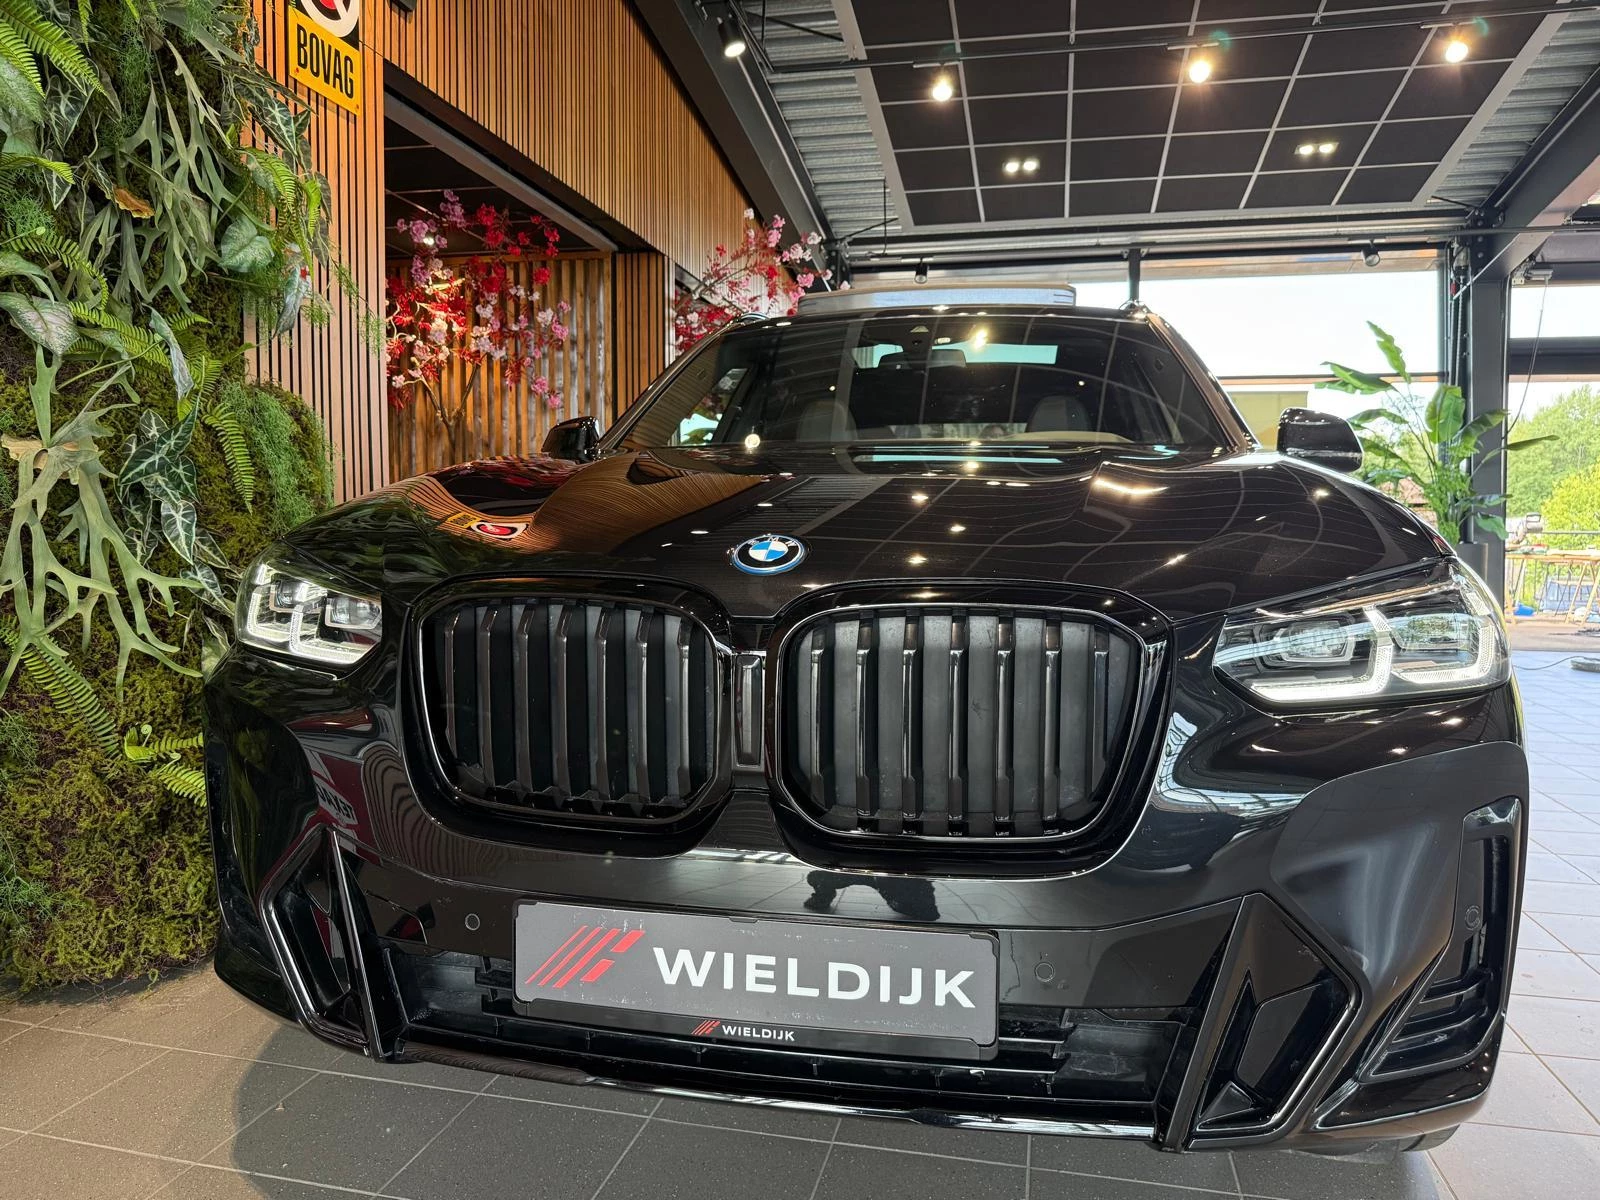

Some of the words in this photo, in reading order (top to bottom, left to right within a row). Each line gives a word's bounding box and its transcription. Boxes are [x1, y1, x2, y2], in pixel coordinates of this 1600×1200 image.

[297, 23, 354, 99] BOVAG
[652, 946, 976, 1008] WIELDIJK
[722, 1025, 795, 1042] WIELDIJK
